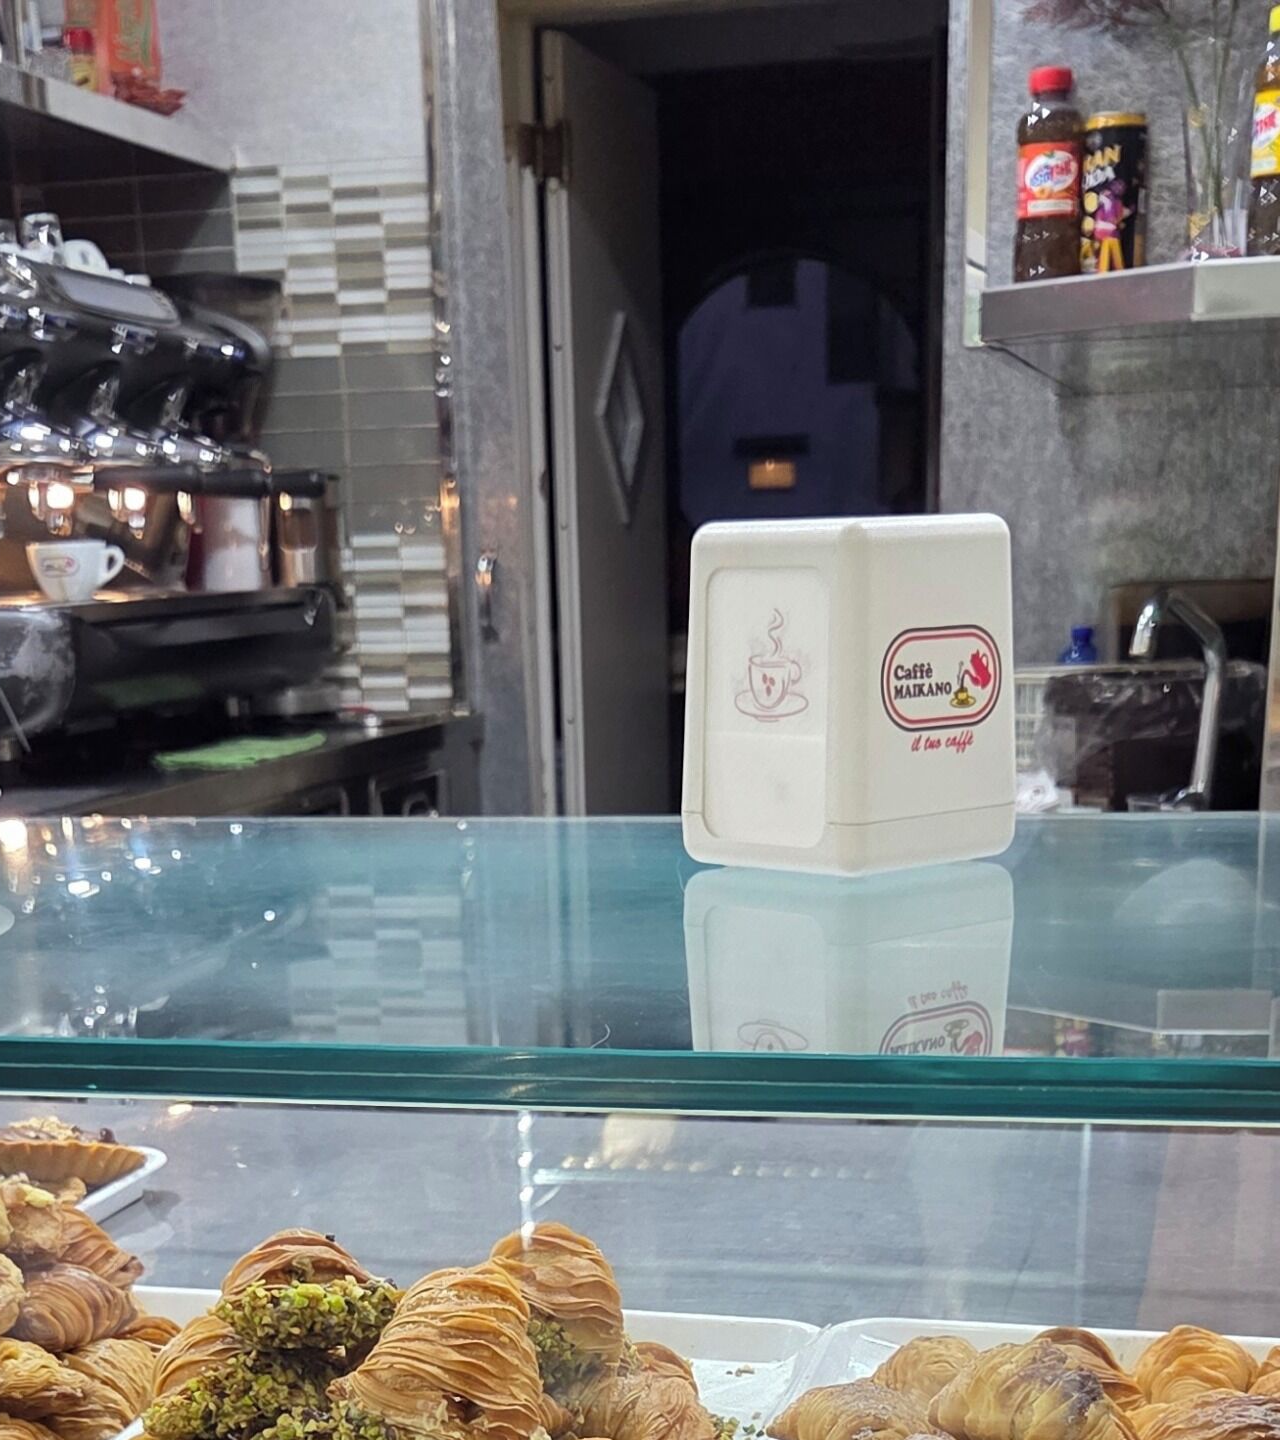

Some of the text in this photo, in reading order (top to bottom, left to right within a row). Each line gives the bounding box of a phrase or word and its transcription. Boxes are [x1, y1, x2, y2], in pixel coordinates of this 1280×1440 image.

[894, 662, 933, 681] Caffè
[894, 682, 952, 700] MAIKANO
[910, 730, 974, 753] il tuo caffè
